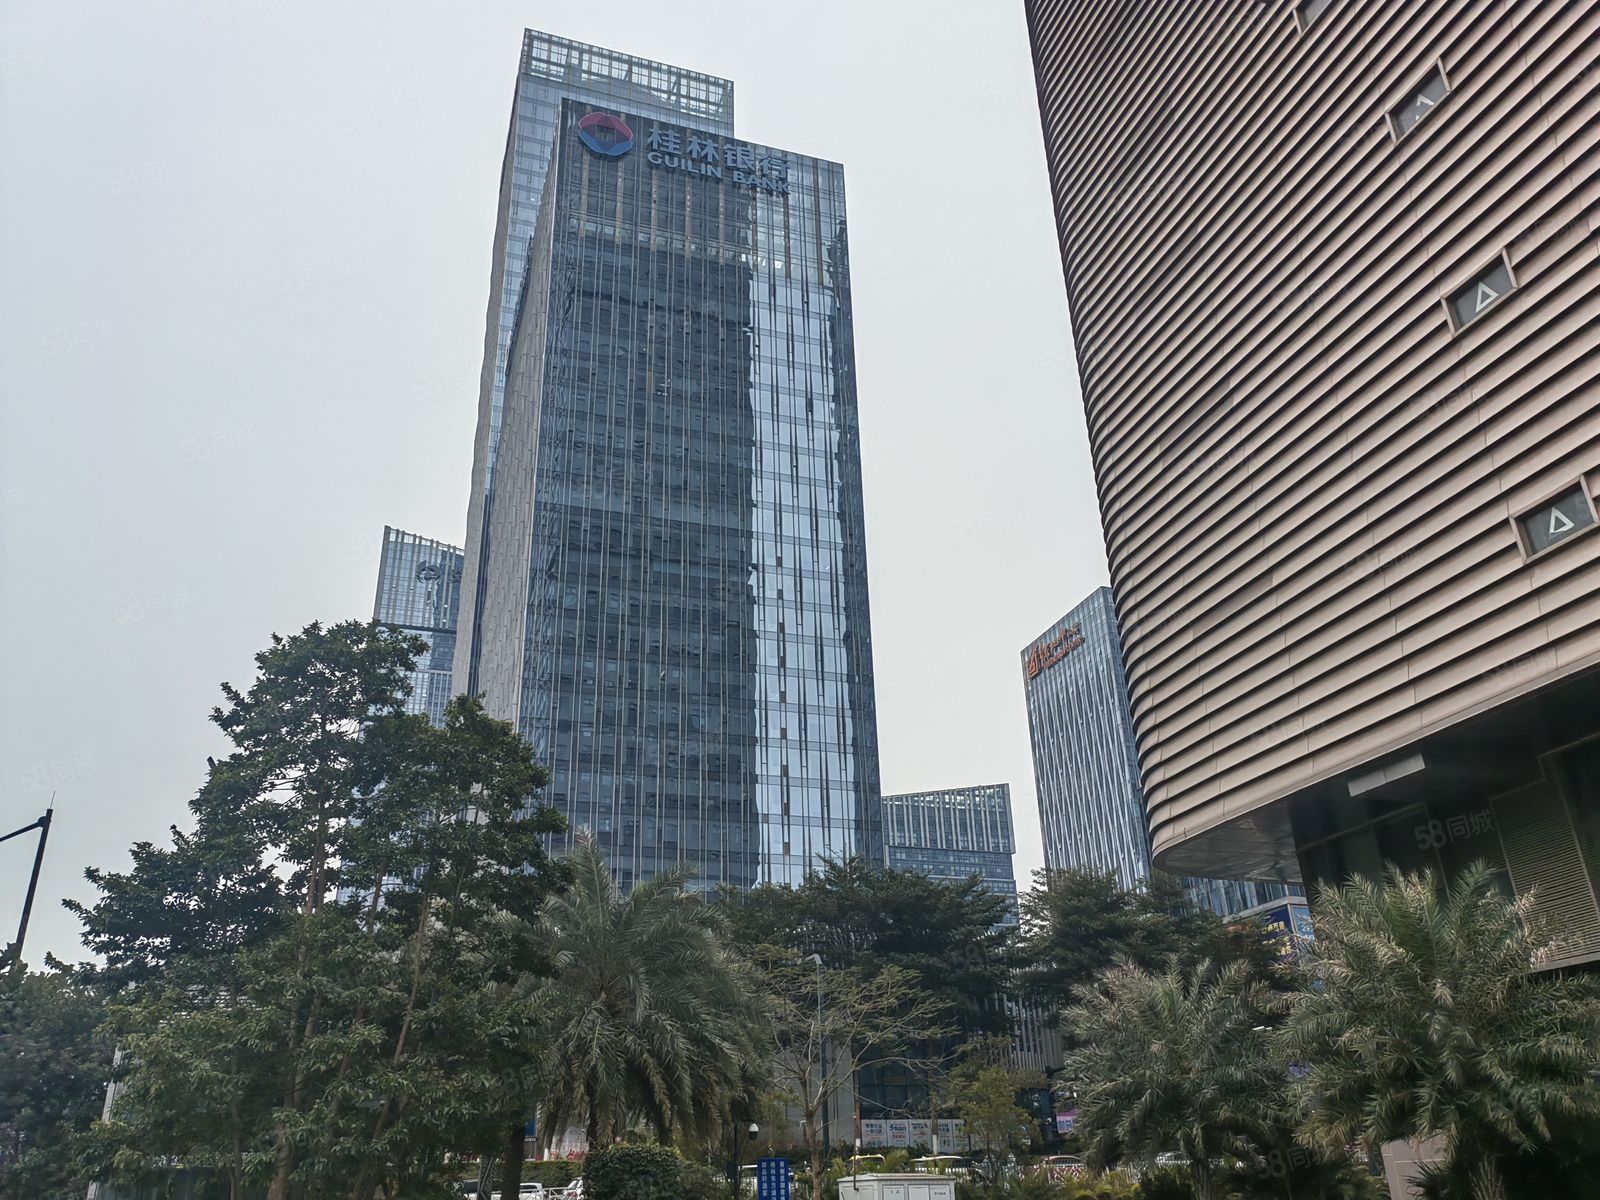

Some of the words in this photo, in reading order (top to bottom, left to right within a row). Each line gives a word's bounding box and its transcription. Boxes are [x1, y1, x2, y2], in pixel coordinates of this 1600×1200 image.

[647, 152, 722, 178] GUILIN
[732, 170, 791, 194] BANK
[648, 127, 790, 179] 桂林银行
